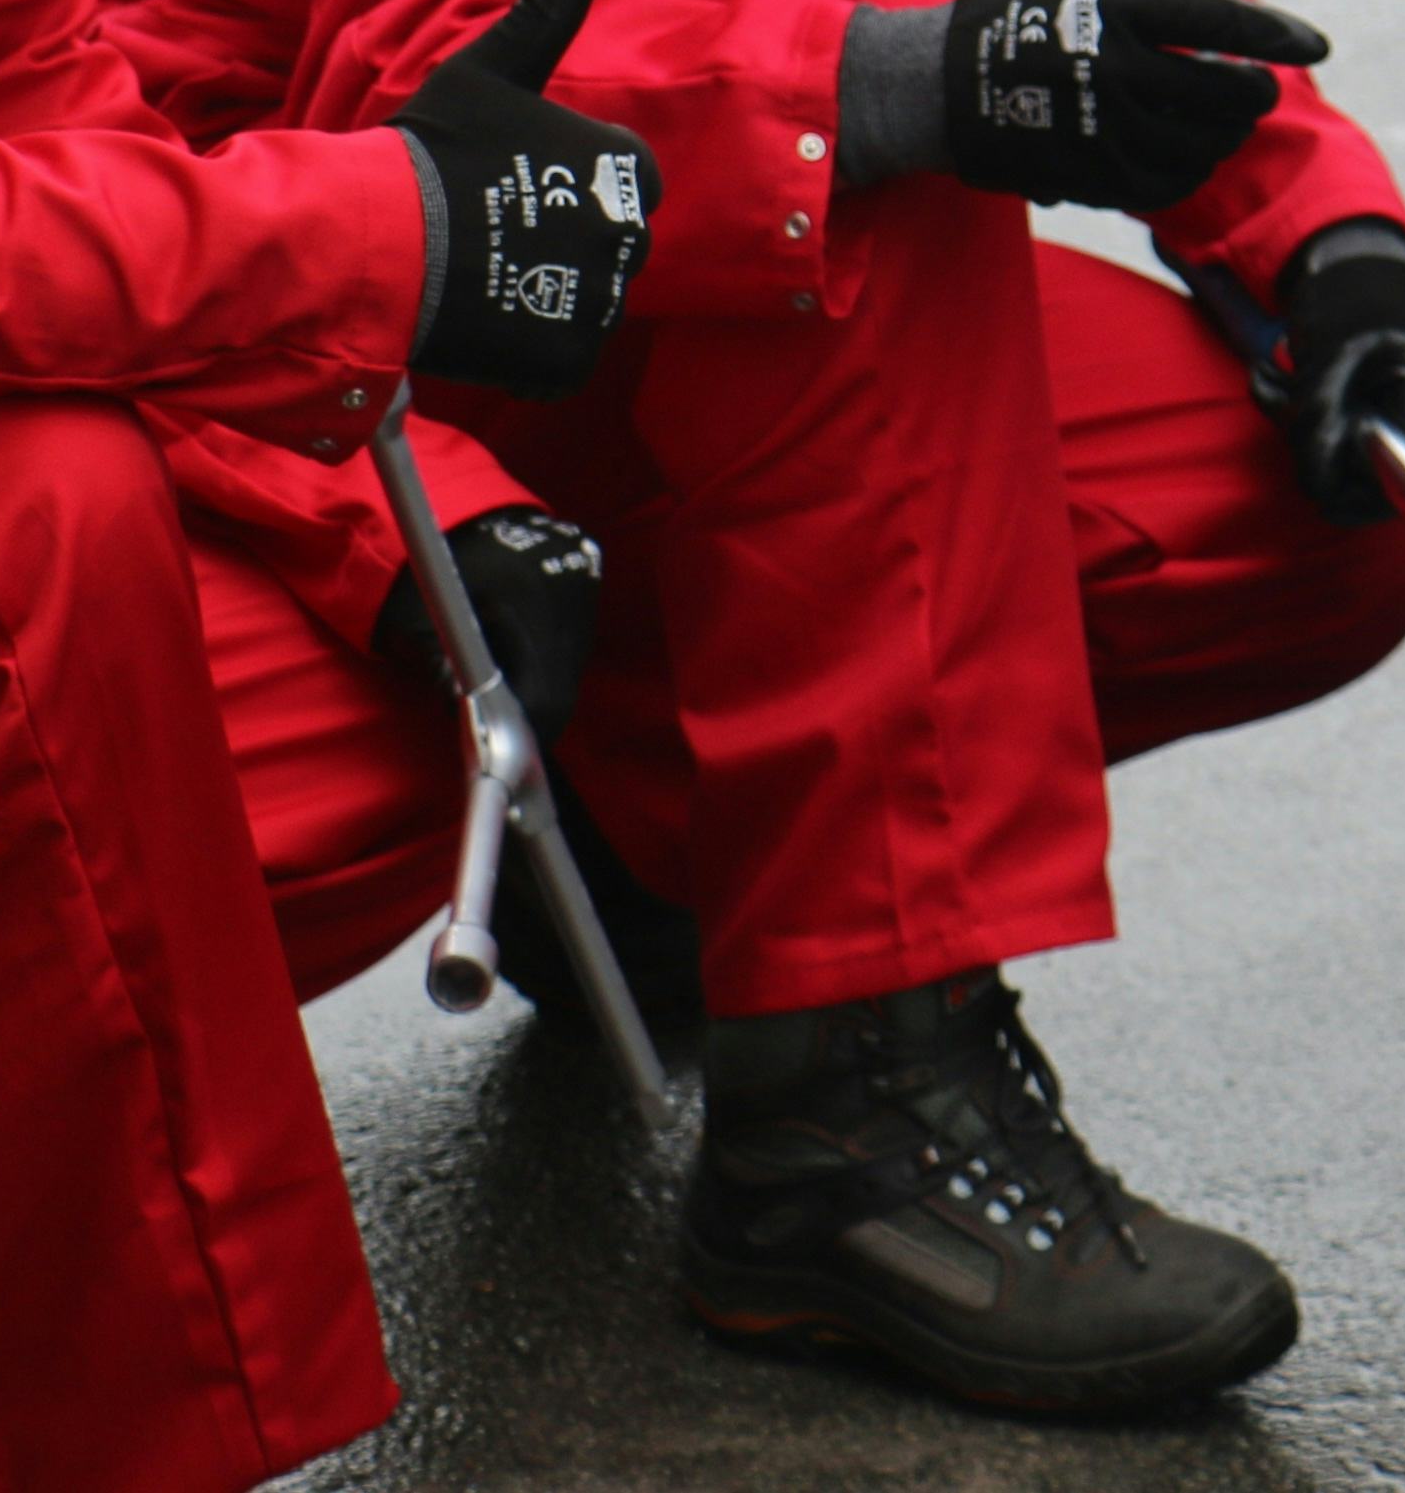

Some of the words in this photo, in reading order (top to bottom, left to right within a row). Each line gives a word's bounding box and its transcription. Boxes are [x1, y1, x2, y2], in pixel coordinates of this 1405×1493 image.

[513, 154, 536, 194] Hand
[541, 165, 579, 207] CE
[523, 195, 538, 228] Size
[486, 252, 504, 298] Korea
